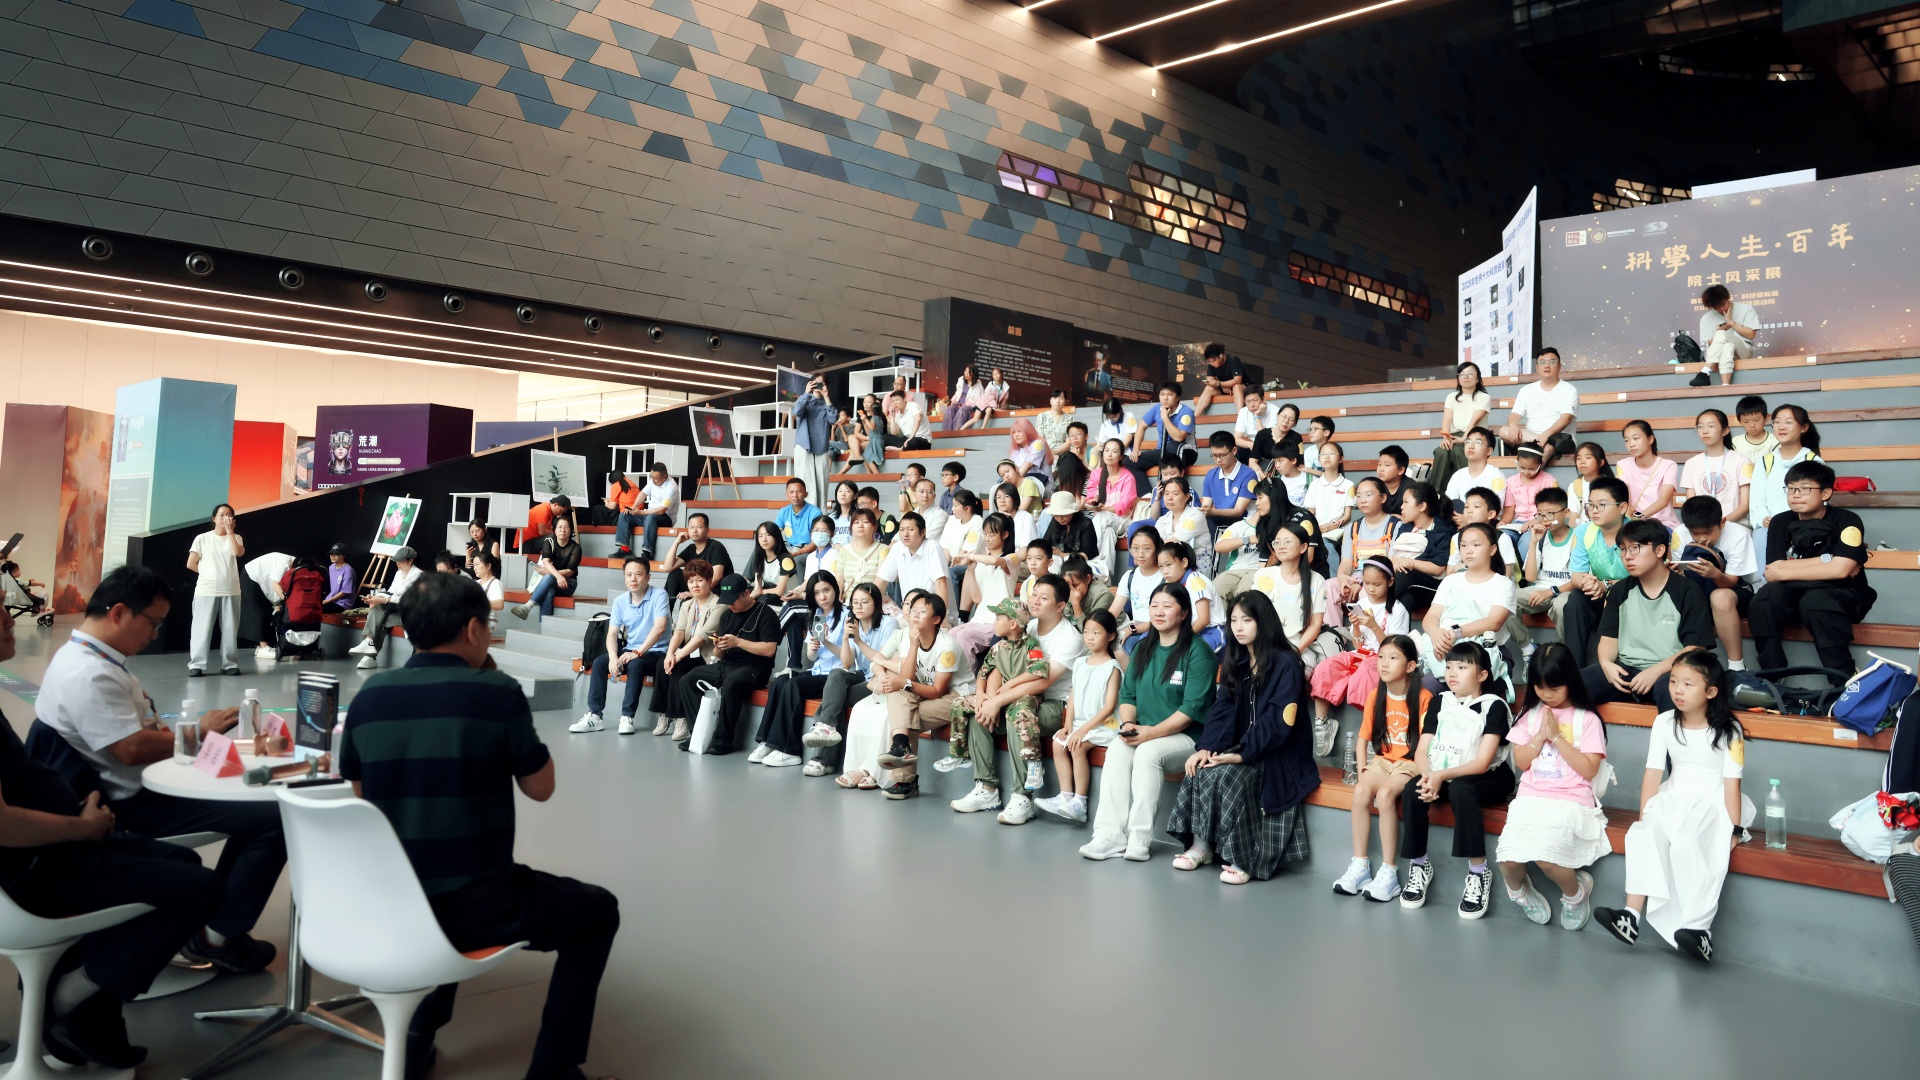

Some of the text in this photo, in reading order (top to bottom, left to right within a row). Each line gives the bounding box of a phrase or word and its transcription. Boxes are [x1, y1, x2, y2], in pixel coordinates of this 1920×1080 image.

[1687, 266, 1782, 288] 院士风采展
[1007, 325, 1022, 337] 前言
[1176, 354, 1185, 383] 化学部
[358, 435, 378, 447] 荒潮
